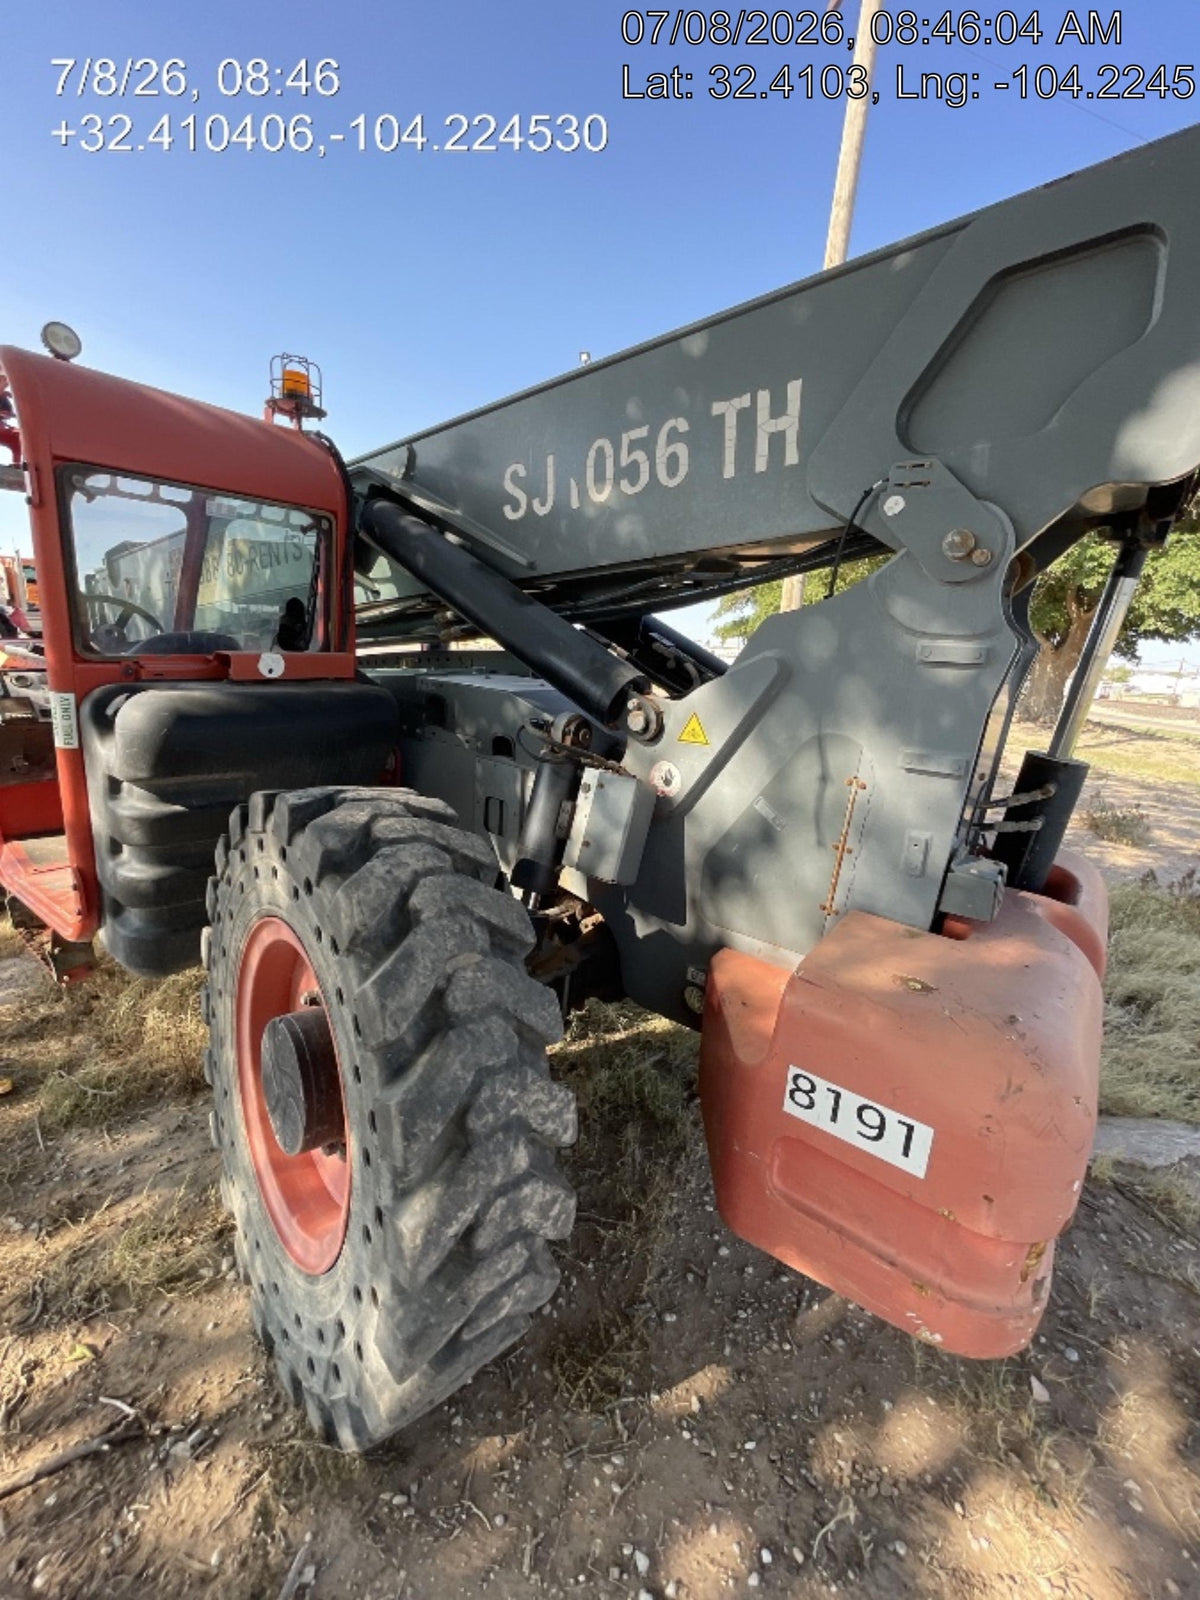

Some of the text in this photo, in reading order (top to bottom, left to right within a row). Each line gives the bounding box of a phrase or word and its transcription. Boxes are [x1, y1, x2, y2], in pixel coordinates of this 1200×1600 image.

[711, 378, 803, 479] TH
[60, 696, 71, 720] ONLY
[788, 1073, 915, 1158] 8191
